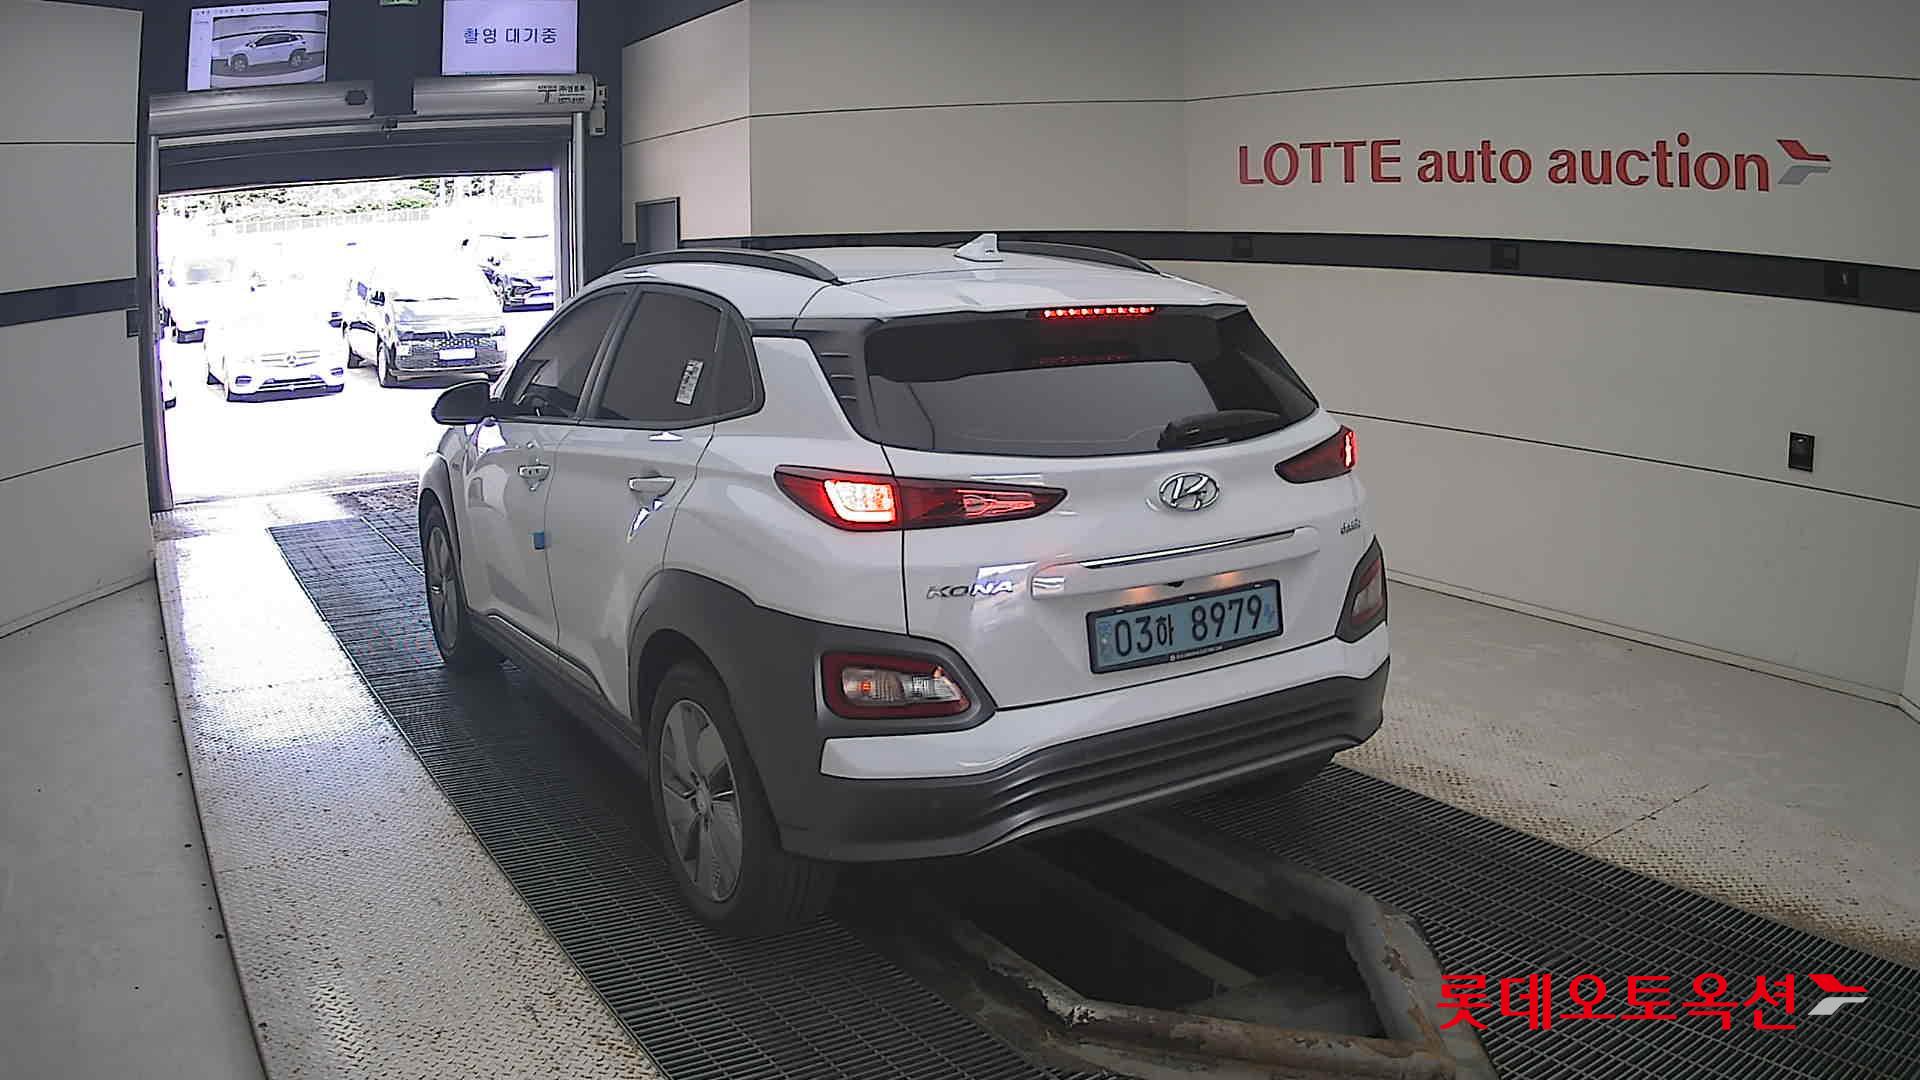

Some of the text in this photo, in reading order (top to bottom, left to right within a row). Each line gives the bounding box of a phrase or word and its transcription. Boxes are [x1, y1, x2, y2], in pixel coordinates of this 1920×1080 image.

[464, 27, 558, 44] 촬영 대기중
[1239, 132, 1769, 192] LOTTE auto auction
[927, 580, 1013, 599] KONA
[1115, 613, 1175, 656] 03하
[1192, 595, 1262, 641] 8979
